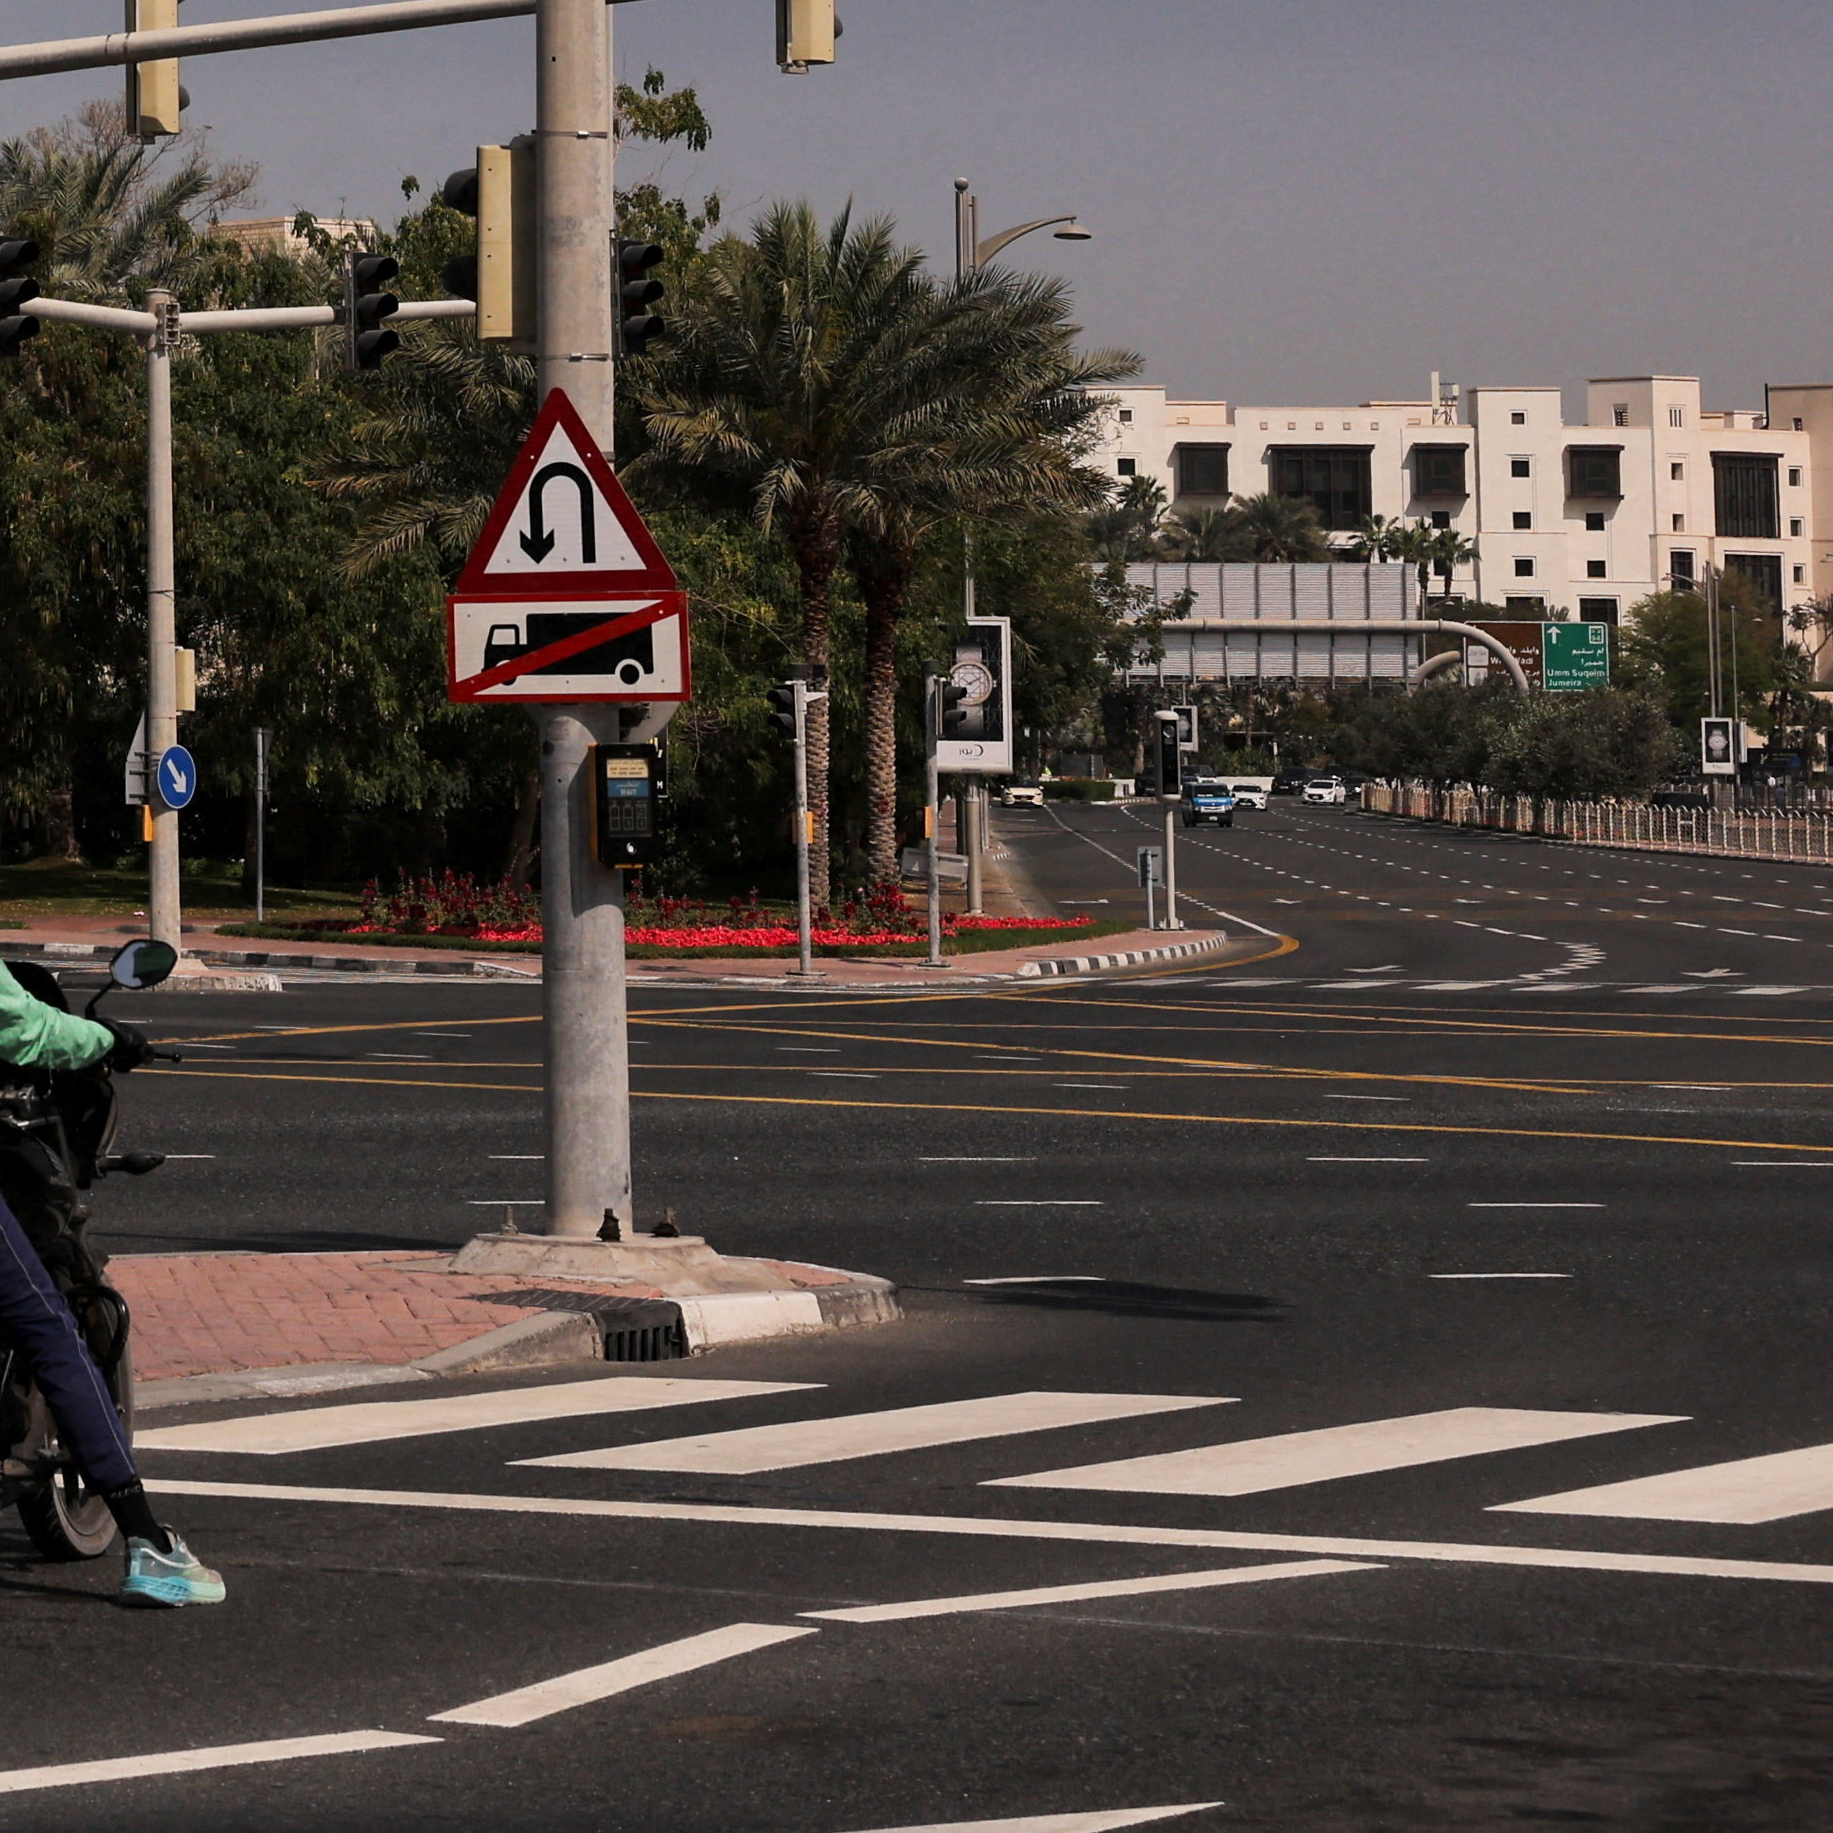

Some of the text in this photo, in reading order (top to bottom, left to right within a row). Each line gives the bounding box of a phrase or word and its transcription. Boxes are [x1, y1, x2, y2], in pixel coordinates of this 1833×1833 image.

[1547, 669, 1605, 679] Umm Suqeim
[1548, 679, 1581, 687] Jumeira
